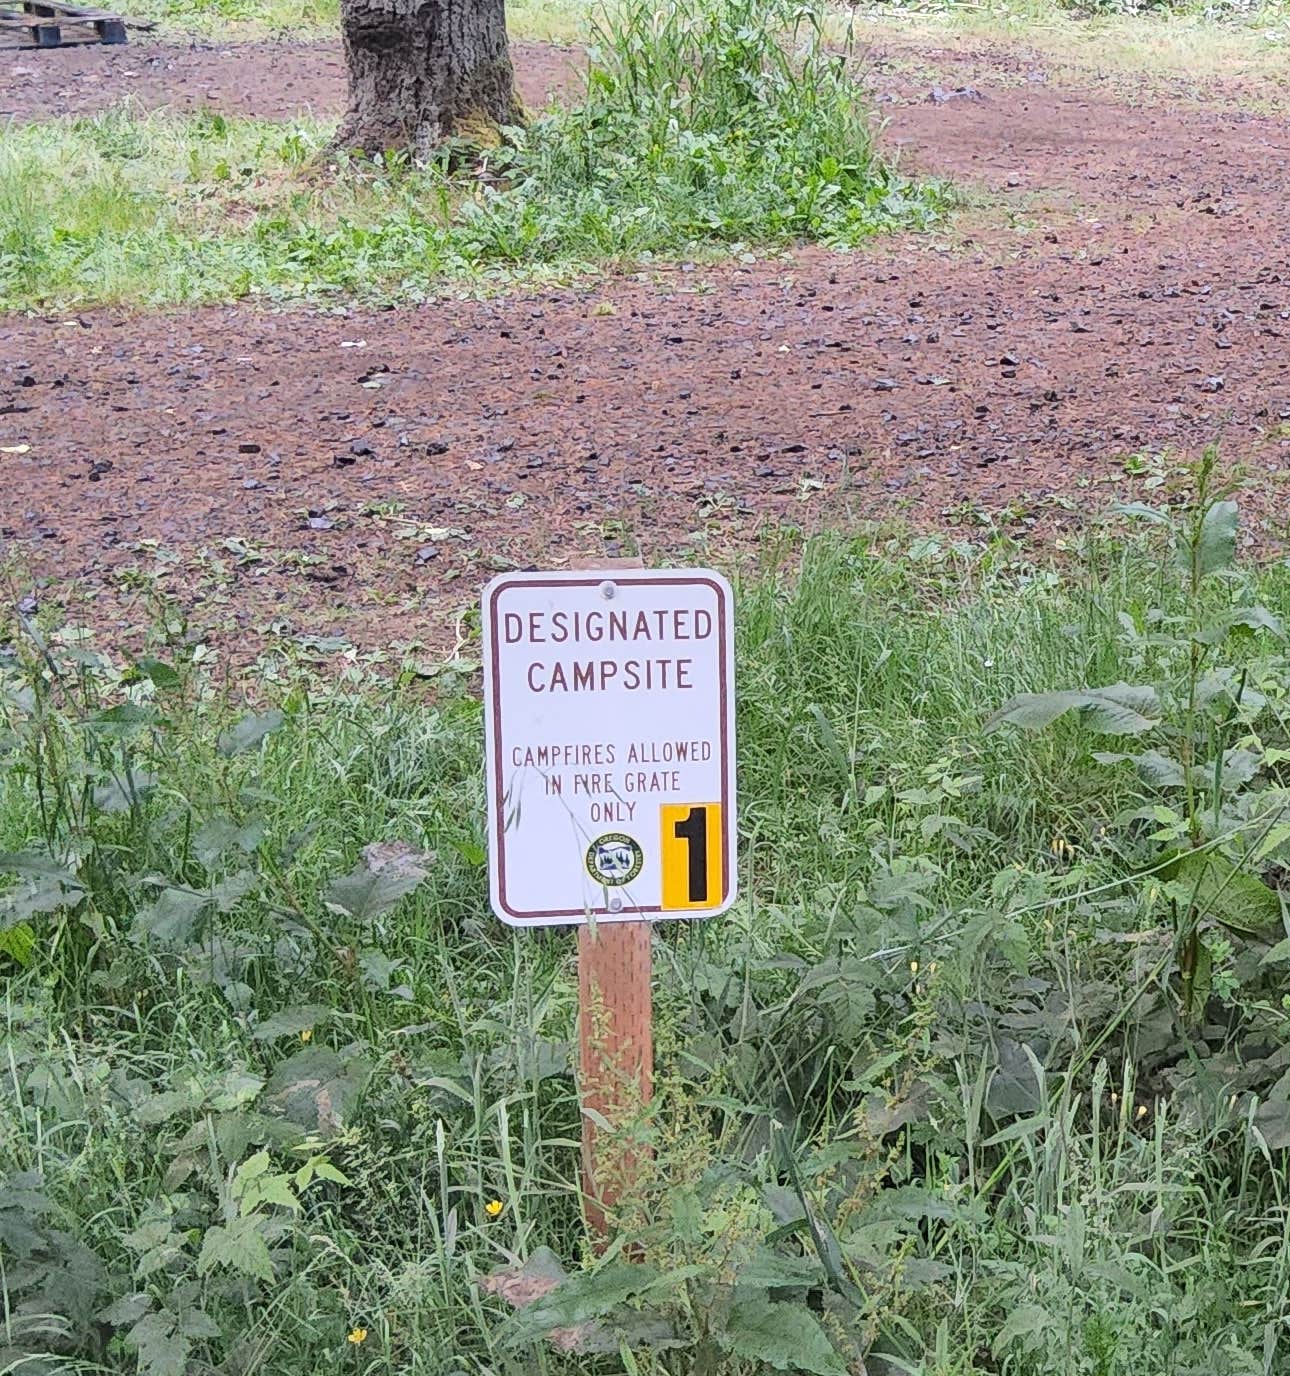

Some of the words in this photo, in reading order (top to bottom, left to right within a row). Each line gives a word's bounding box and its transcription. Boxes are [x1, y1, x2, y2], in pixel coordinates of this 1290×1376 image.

[504, 609, 712, 644] DESIGNATED
[527, 659, 693, 693] CAMPSITE
[512, 744, 616, 767] CAMPFIRES
[627, 741, 711, 764] ALLOWED
[544, 774, 562, 796] IN
[574, 773, 613, 795] FIRE
[624, 771, 681, 793] GRATE
[590, 801, 636, 822] ONLY
[674, 807, 708, 903] 1
